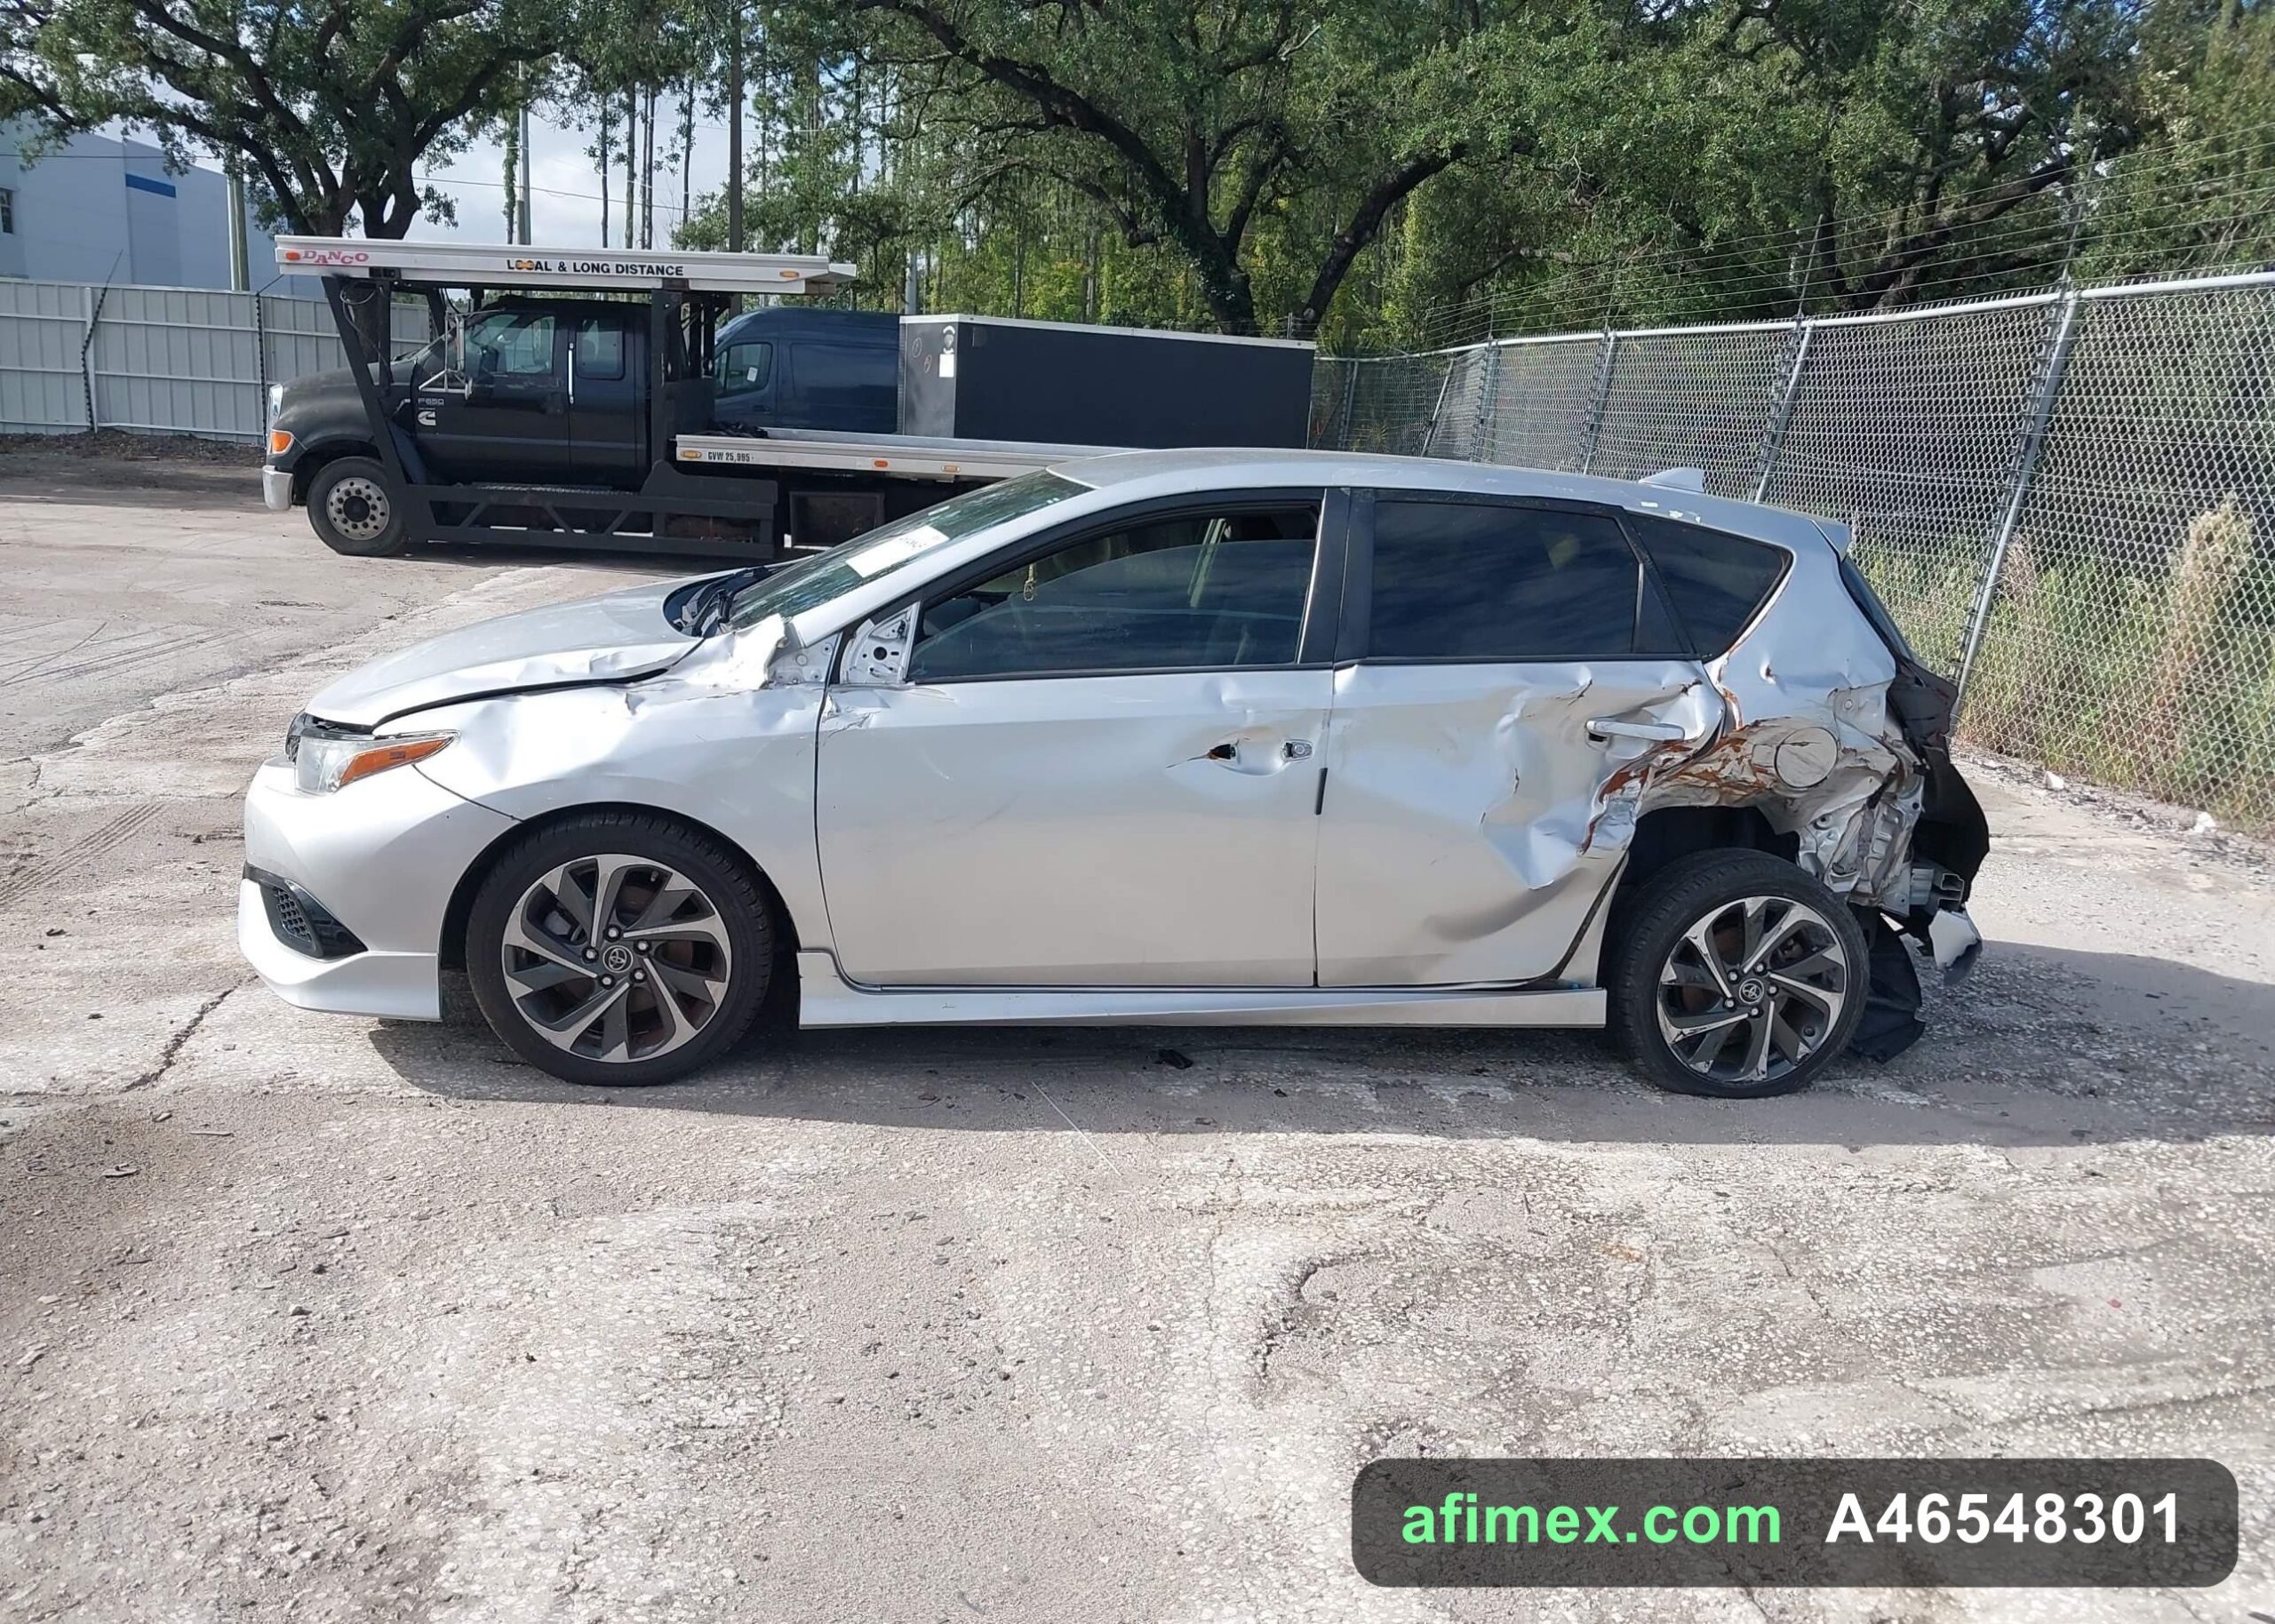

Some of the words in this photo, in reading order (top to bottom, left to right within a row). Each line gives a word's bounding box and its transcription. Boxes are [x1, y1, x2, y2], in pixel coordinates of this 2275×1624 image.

[303, 250, 370, 265] DANCO
[557, 261, 568, 273] &
[572, 262, 611, 274] LONG
[615, 264, 683, 276] DISTANCE
[707, 451, 724, 461] GVW
